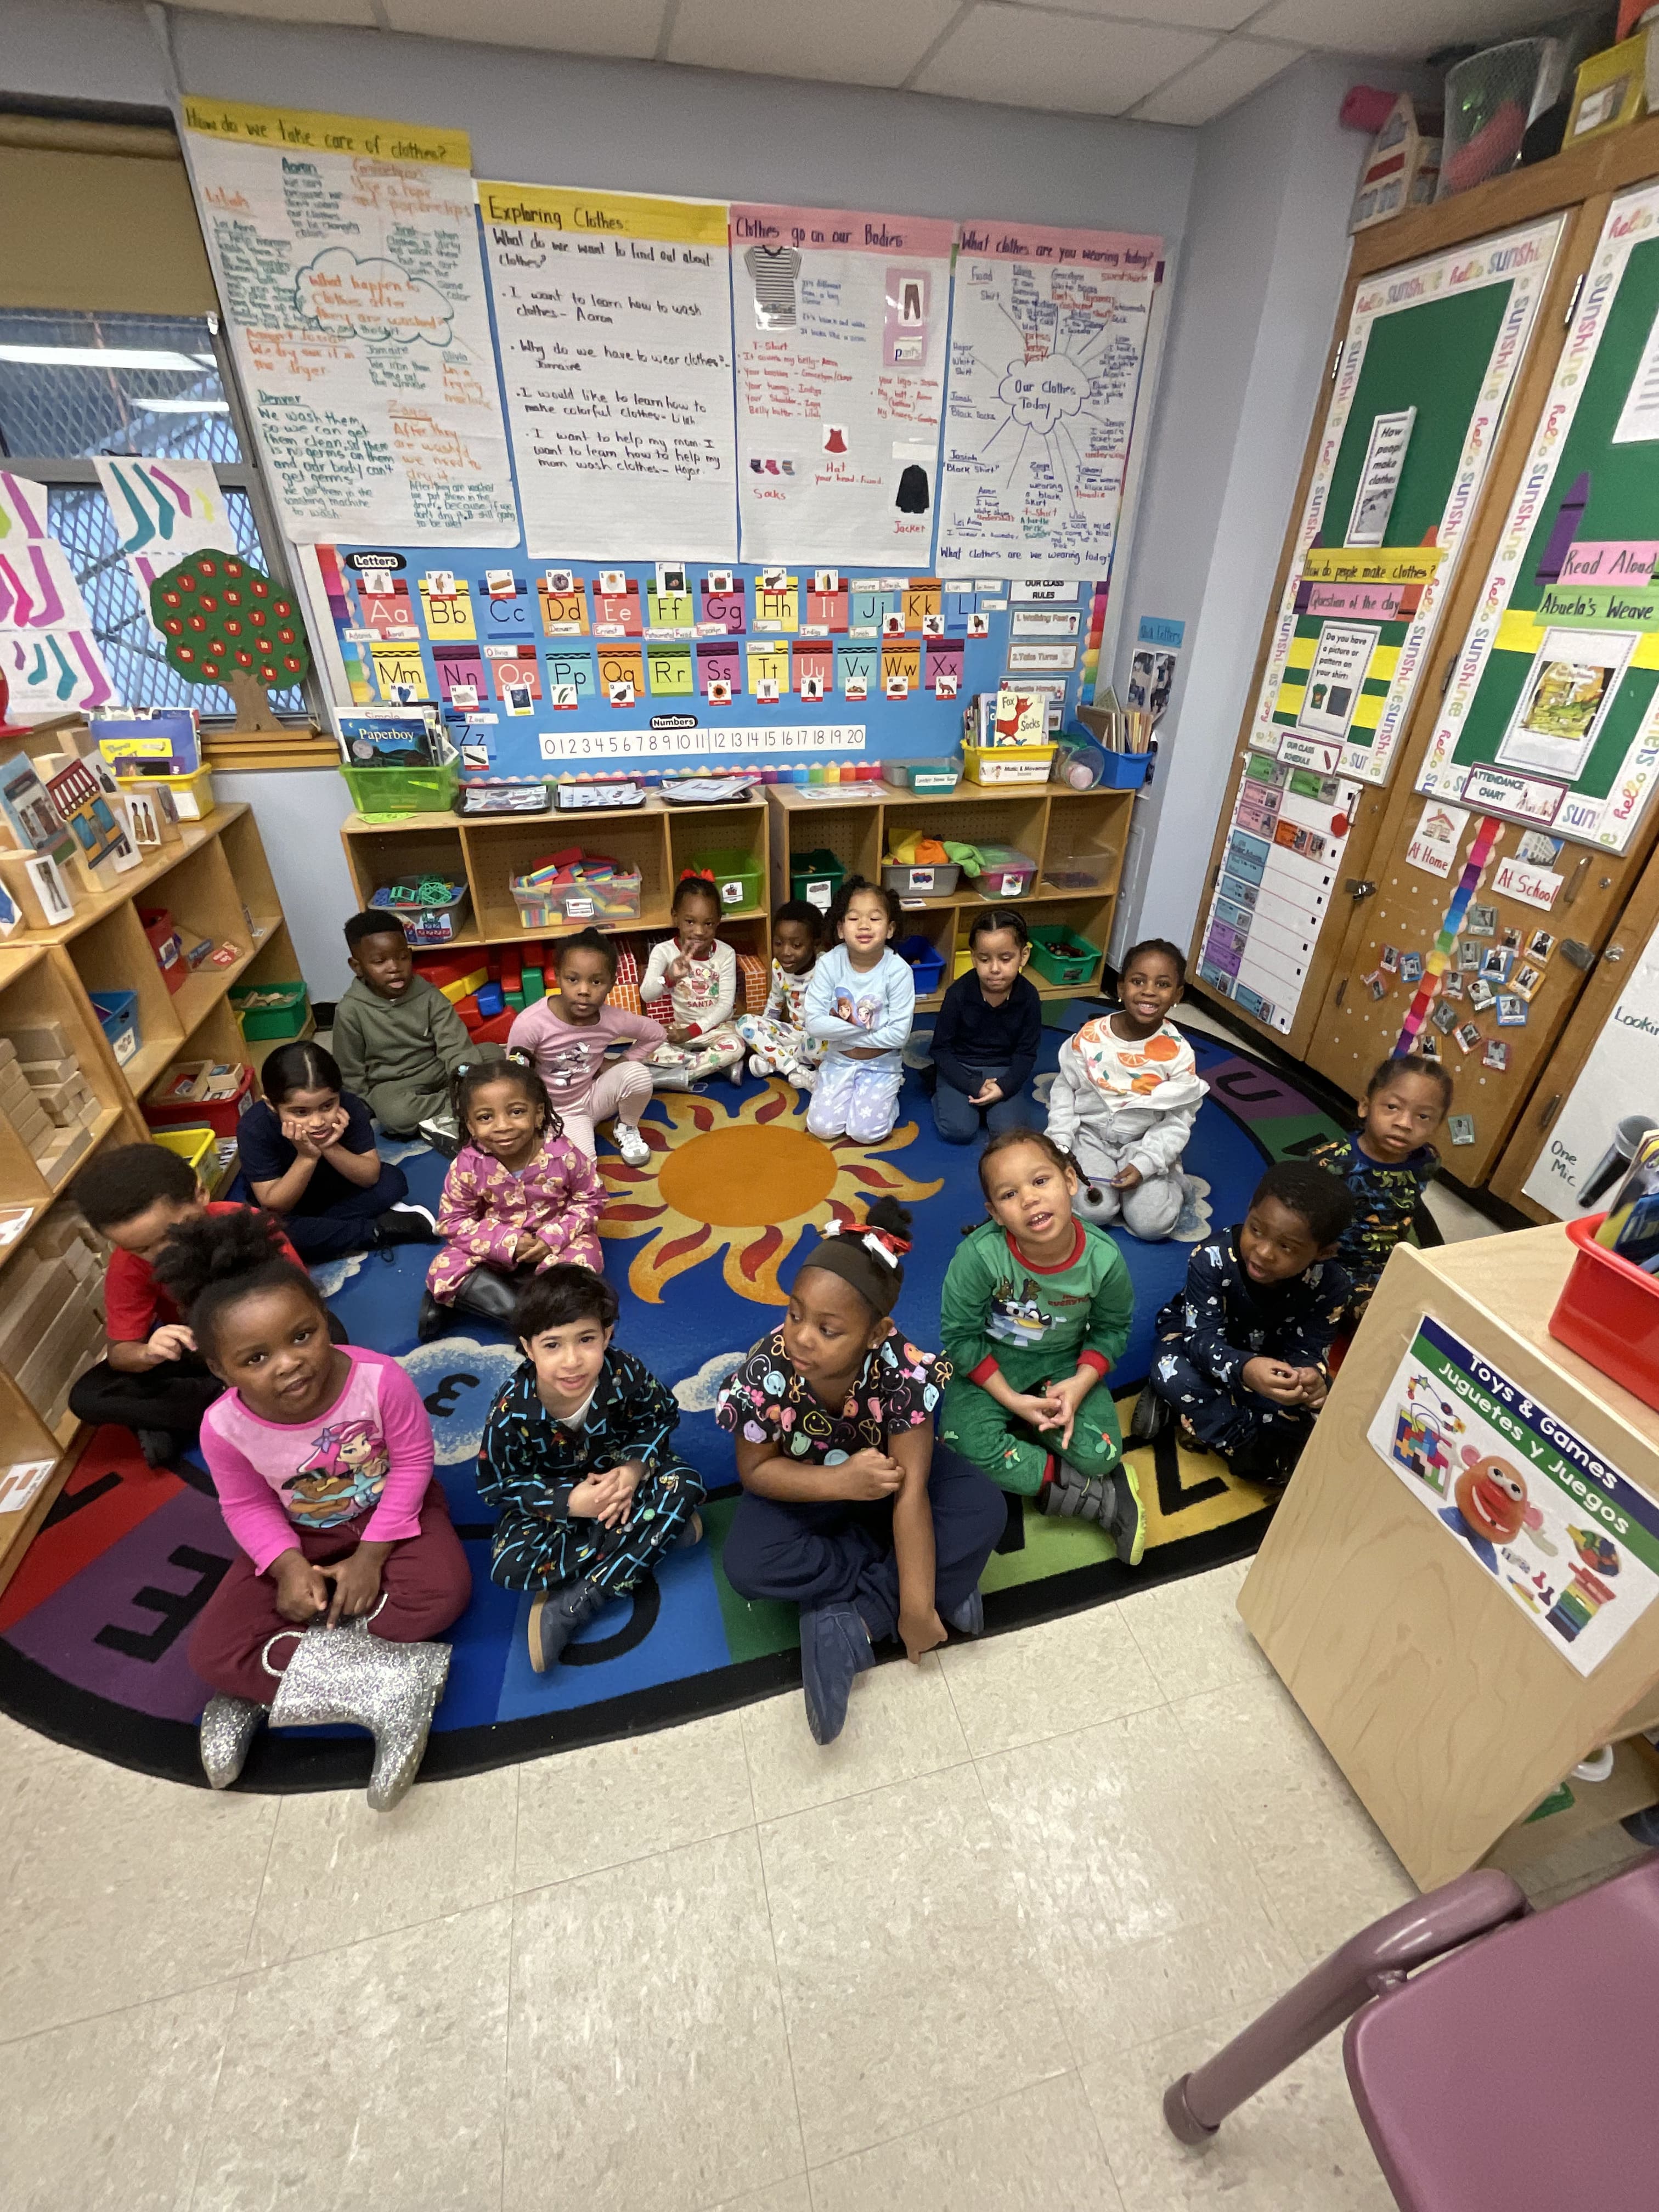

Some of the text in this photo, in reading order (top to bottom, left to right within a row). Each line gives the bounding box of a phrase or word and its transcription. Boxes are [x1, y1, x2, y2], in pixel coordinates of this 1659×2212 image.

[186, 108, 217, 132] How
[221, 114, 239, 133] do
[246, 122, 267, 137] we
[279, 119, 312, 147] take
[325, 134, 354, 151] care
[365, 134, 380, 153] of
[489, 196, 561, 229] Exploring
[736, 218, 903, 247] Clothes go on our Bodies
[493, 228, 711, 267] What do we want to find out about
[962, 231, 989, 251] What
[996, 236, 1030, 255] clothes
[1036, 245, 1052, 257] are
[1059, 247, 1077, 263] you
[1082, 248, 1119, 266] wearing
[531, 289, 702, 316] want to learn how to wash
[1015, 380, 1076, 395] Our Clothes
[538, 387, 707, 413] would like to learn how to
[1019, 397, 1051, 419] Today
[1381, 427, 1404, 438] How
[826, 462, 846, 473] Hat
[1373, 459, 1397, 470] make
[354, 555, 398, 568] Letters
[1304, 560, 1319, 576] How
[1322, 560, 1332, 576] do
[1335, 566, 1358, 580] people
[1362, 565, 1386, 578] make
[1562, 550, 1657, 576] Read Aloud
[370, 600, 409, 623] Aa
[430, 600, 466, 624] Bb
[490, 599, 526, 623] Cc
[546, 597, 581, 622] Dd
[605, 599, 631, 622] Ee
[658, 597, 682, 620] Ff
[707, 597, 742, 628] Gg
[764, 595, 791, 618] Hh
[822, 596, 834, 618] Ii
[863, 596, 884, 628] Jj
[909, 596, 932, 617] Kk
[1310, 589, 1401, 617] Question of the day
[1539, 593, 1655, 620] Abuela's Weave
[1326, 633, 1367, 645] Do you have
[1329, 646, 1350, 656] picture
[379, 662, 422, 685] Mm
[444, 664, 478, 686] Nn
[498, 664, 535, 685] Oo
[603, 661, 641, 692] Qq
[655, 661, 686, 684] Rr
[707, 660, 732, 681] Ss
[758, 658, 778, 680] Tt
[800, 658, 825, 678] Uu
[845, 657, 870, 678] Vv
[884, 657, 917, 677] Ww
[932, 656, 957, 676] Xx
[1316, 669, 1331, 679] your
[555, 663, 586, 695] Pp
[1002, 696, 1014, 709] Fox
[653, 718, 693, 726] Numbers
[1021, 719, 1040, 732] Socks
[359, 727, 414, 742] Paperboy
[455, 725, 485, 747] Zz
[1473, 770, 1526, 791] ATTENDANCE
[1478, 786, 1506, 802] CHART
[1408, 842, 1449, 872] At Home
[1497, 867, 1560, 904] At School
[1550, 1139, 1578, 1166] One
[1551, 1157, 1577, 1188] Mic
[1468, 1354, 1618, 1491] Toys & Games
[1438, 1361, 1631, 1535] Juguetes y Juegos
